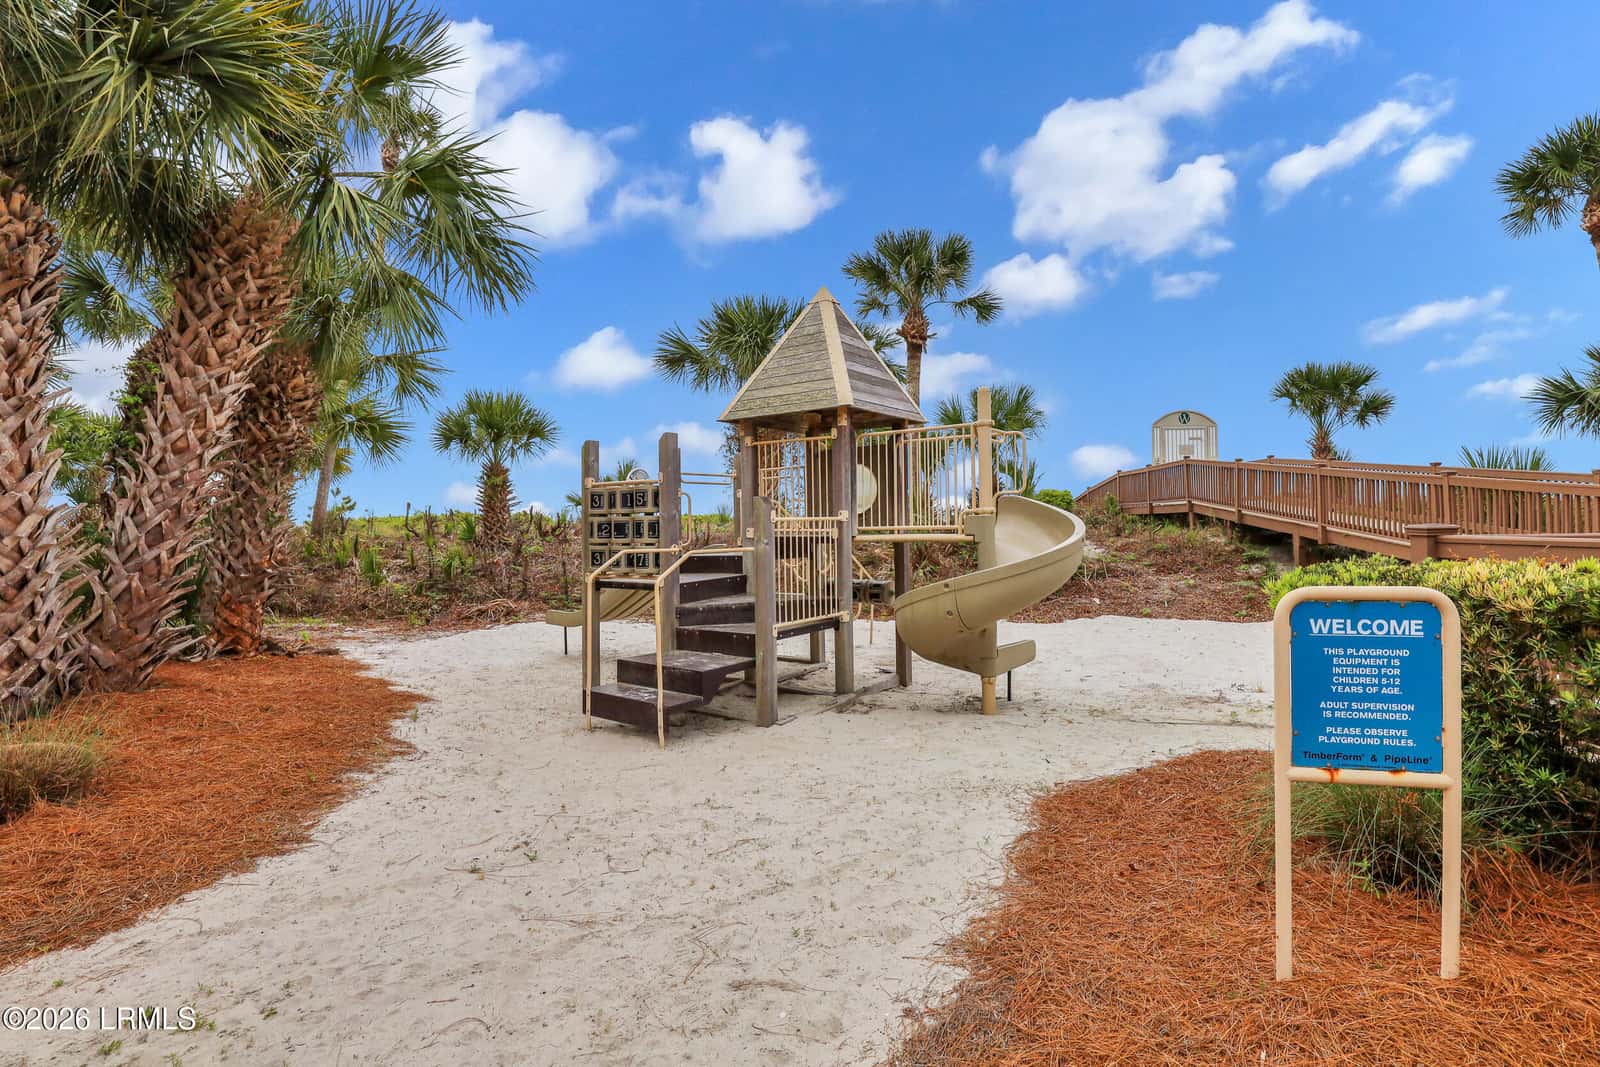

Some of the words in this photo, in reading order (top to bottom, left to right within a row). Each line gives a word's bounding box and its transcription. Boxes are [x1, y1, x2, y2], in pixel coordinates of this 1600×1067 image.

[1309, 618, 1424, 636] WELCOME
[1347, 648, 1410, 657] PLAYGROUND
[1333, 658, 1388, 666] EQUIPMENT
[1391, 658, 1400, 666] IS
[1332, 667, 1378, 675] INTENDED
[1381, 668, 1401, 676] FOR
[1333, 677, 1379, 685] CHILDREN
[1331, 686, 1363, 694] YEARS
[1366, 686, 1379, 694] OF
[1381, 687, 1403, 695] AGE.
[1319, 701, 1349, 709] ADULT
[1351, 702, 1415, 711] SUPERVISION
[1323, 710, 1332, 718] IS
[1335, 711, 1412, 720] RECOMMENDED.
[1326, 726, 1361, 735] PLEASE
[1364, 728, 1408, 737] OBSERVE
[1318, 735, 1380, 745] PLAYGROUND
[1383, 737, 1417, 747] RULES.
[1370, 754, 1378, 762] &
